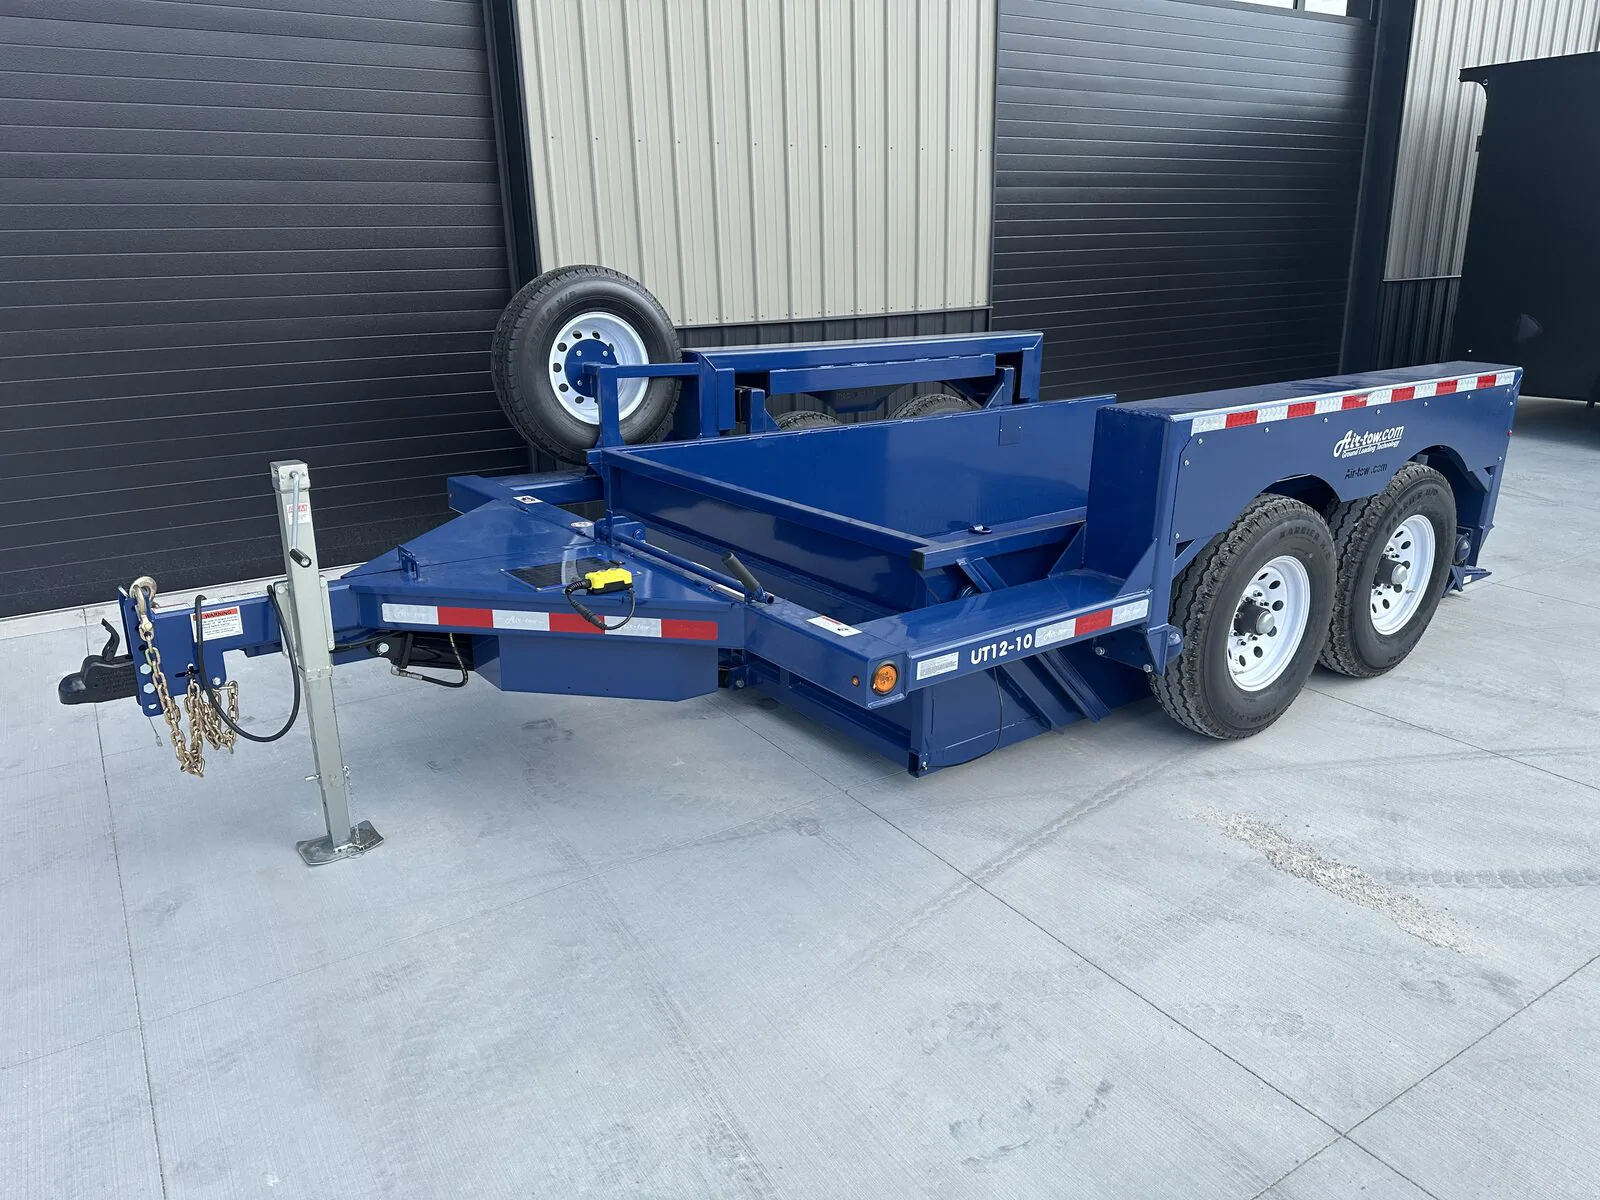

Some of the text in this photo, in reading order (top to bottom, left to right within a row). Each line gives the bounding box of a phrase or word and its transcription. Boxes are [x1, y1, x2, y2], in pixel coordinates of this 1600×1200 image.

[1333, 425, 1404, 458] Air-tow.com
[1341, 448, 1359, 459] Ground
[1358, 443, 1377, 455] Loading
[204, 609, 232, 619] WARNING
[970, 633, 1033, 665] UT12-10
